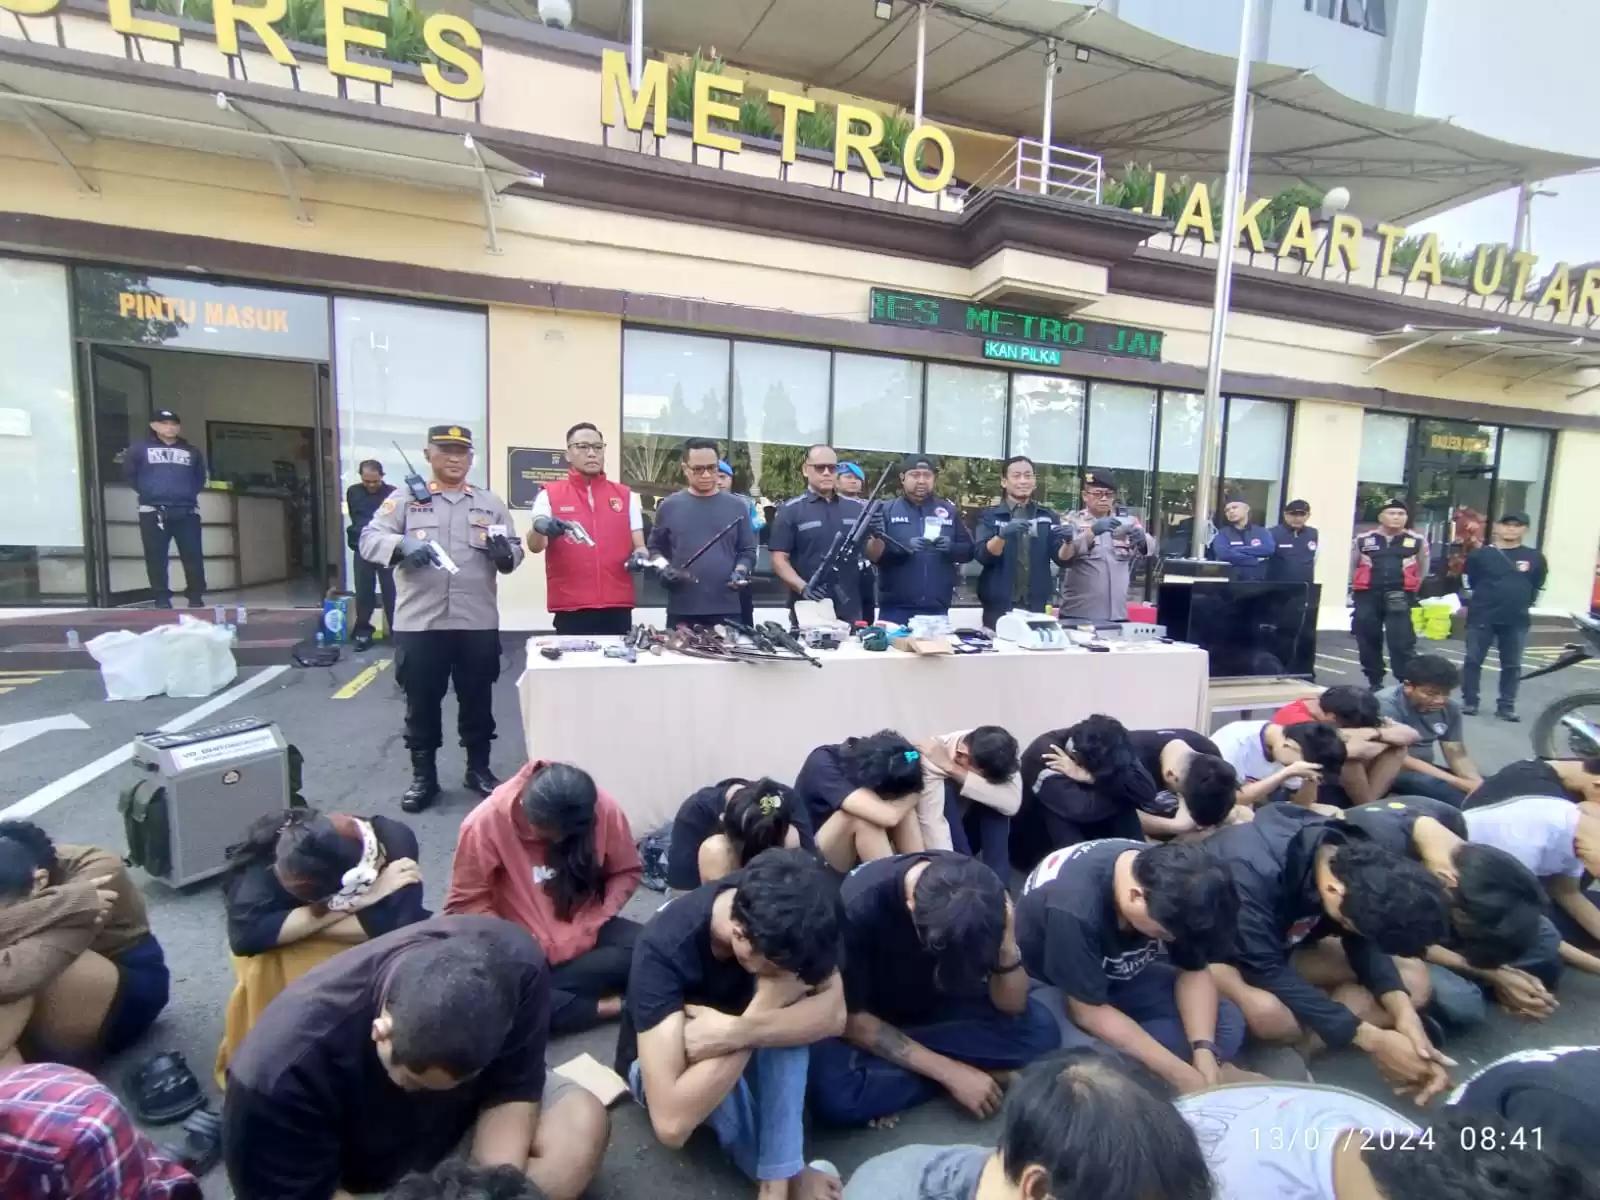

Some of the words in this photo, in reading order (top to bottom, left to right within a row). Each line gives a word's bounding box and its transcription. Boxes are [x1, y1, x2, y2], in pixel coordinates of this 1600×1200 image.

[601, 48, 956, 193] METRO
[1132, 172, 1444, 286] JAKARTA
[119, 292, 197, 324] PINTU
[205, 302, 289, 333] MASUK
[966, 305, 1085, 345] METRO
